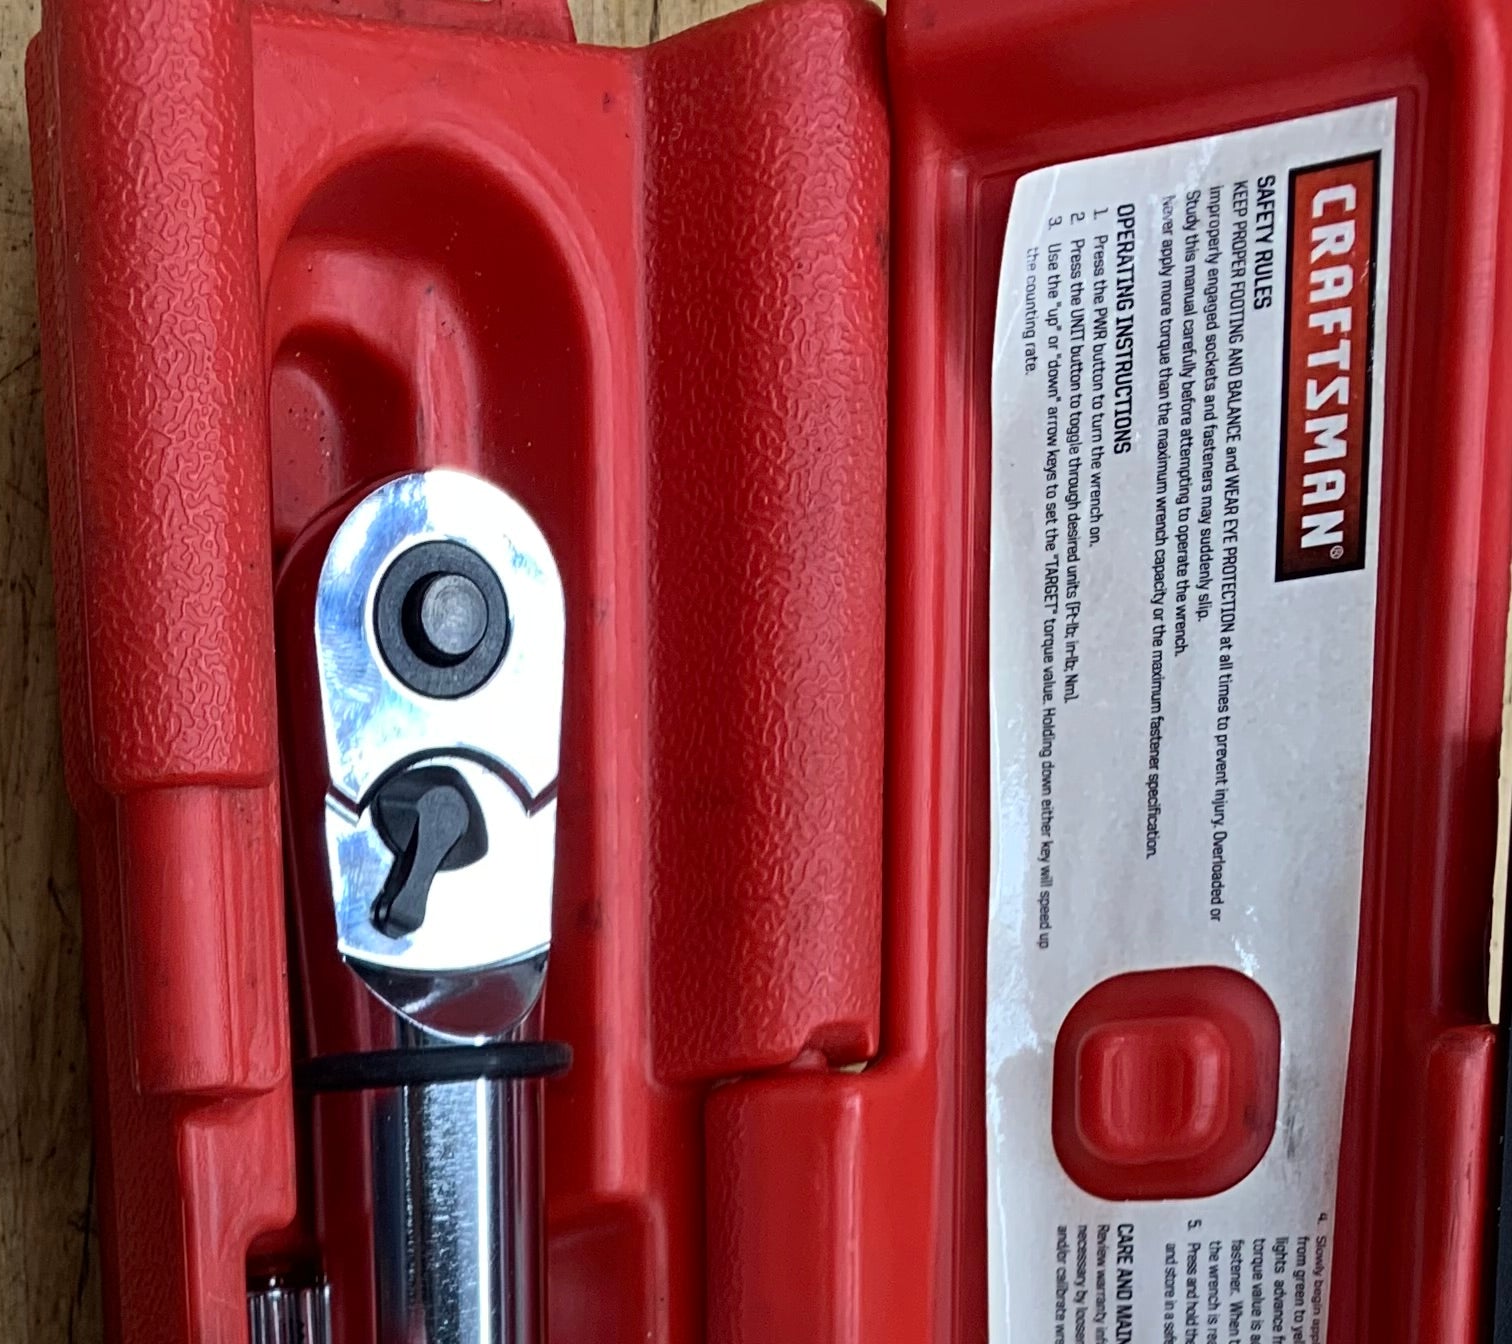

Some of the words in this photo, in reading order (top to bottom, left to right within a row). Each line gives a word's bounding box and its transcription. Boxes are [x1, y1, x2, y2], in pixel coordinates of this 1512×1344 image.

[1182, 190, 1202, 231] Study
[1233, 180, 1249, 217] KEEP
[1256, 174, 1276, 243] SAFETY
[1027, 247, 1040, 271] the
[1048, 242, 1062, 271] Use
[1071, 238, 1086, 280] Press
[1094, 234, 1109, 277] Press
[1116, 203, 1136, 312] OPERATING
[1158, 239, 1177, 277] apply
[1185, 233, 1201, 263] this
[1231, 220, 1248, 279] PROPER
[1048, 274, 1063, 299] the
[1071, 281, 1085, 306] the
[1094, 279, 1109, 305] the
[1160, 279, 1173, 316] more
[1184, 264, 1199, 317] manual
[1203, 268, 1221, 331] engaged
[1254, 249, 1274, 310] RULES
[1022, 275, 1039, 339] counting
[1071, 308, 1086, 341] UNIT
[1093, 307, 1109, 341] PWR
[1229, 280, 1246, 345] FOOTING
[1025, 342, 1039, 376] rate.
[1048, 335, 1059, 350] or
[1157, 318, 1174, 365] torque
[1179, 319, 1198, 378] carefully
[1048, 353, 1063, 403] "down"
[1070, 344, 1085, 392] button
[1092, 342, 1108, 392] button
[1205, 333, 1220, 392] sockets
[1228, 348, 1244, 377] AND
[1070, 393, 1083, 409] to
[1092, 393, 1106, 410] to
[1114, 314, 1135, 455] INSTRUCTIONS
[1159, 366, 1174, 400] than
[1181, 380, 1197, 426] before
[1047, 406, 1059, 447] arrow
[1092, 412, 1106, 443] turn
[1158, 401, 1173, 426] the
[1204, 394, 1219, 422] and
[1226, 379, 1243, 443] BALANCE
[1066, 410, 1084, 455] toggle
[1043, 448, 1061, 482] keys
[1091, 445, 1105, 470] the
[1156, 428, 1172, 495] maximum
[1175, 428, 1194, 505] attempting
[1202, 424, 1219, 493] fasteners
[1226, 446, 1241, 473] and
[1046, 483, 1060, 499] to
[1065, 456, 1083, 511] through
[1090, 471, 1104, 523] wrench
[1224, 474, 1240, 516] WEAR
[1046, 502, 1059, 526] set
[1155, 496, 1170, 547] wrench
[1178, 506, 1192, 522] to
[1198, 495, 1213, 525] may
[1045, 527, 1060, 552] the
[1067, 512, 1082, 563] desired
[1089, 526, 1101, 548] on.
[1174, 524, 1191, 577] operate
[1223, 518, 1239, 544] EYE
[1150, 548, 1168, 605] capacity
[1196, 527, 1215, 590] suddenly
[1044, 553, 1060, 615] "TARGET"
[1066, 565, 1081, 599] units
[1176, 579, 1191, 603] the
[1221, 546, 1238, 633] PROTECTION
[1153, 608, 1165, 622] or
[1195, 593, 1213, 622] slip.
[1041, 618, 1057, 664] torque
[1152, 624, 1167, 647] the
[1175, 604, 1189, 657] wrench.
[1220, 636, 1234, 651] at
[1151, 650, 1166, 714] maximum
[1219, 654, 1234, 671] all
[1043, 665, 1057, 705] value.
[1218, 673, 1233, 713] times
[1039, 707, 1057, 758] Holding
[1149, 715, 1165, 771] fastener
[1217, 715, 1231, 731] to
[1042, 760, 1056, 796] down
[1214, 734, 1229, 786] prevent
[1041, 799, 1055, 838] either
[1211, 788, 1229, 829] injury.
[1038, 840, 1054, 863] key
[1211, 831, 1228, 905] Overloaded
[1041, 865, 1054, 887] will
[1038, 890, 1053, 930] speed
[1210, 908, 1221, 922] or
[1037, 932, 1049, 949] up
[1117, 1223, 1135, 1265] CARE
[1116, 1268, 1134, 1301] AND
